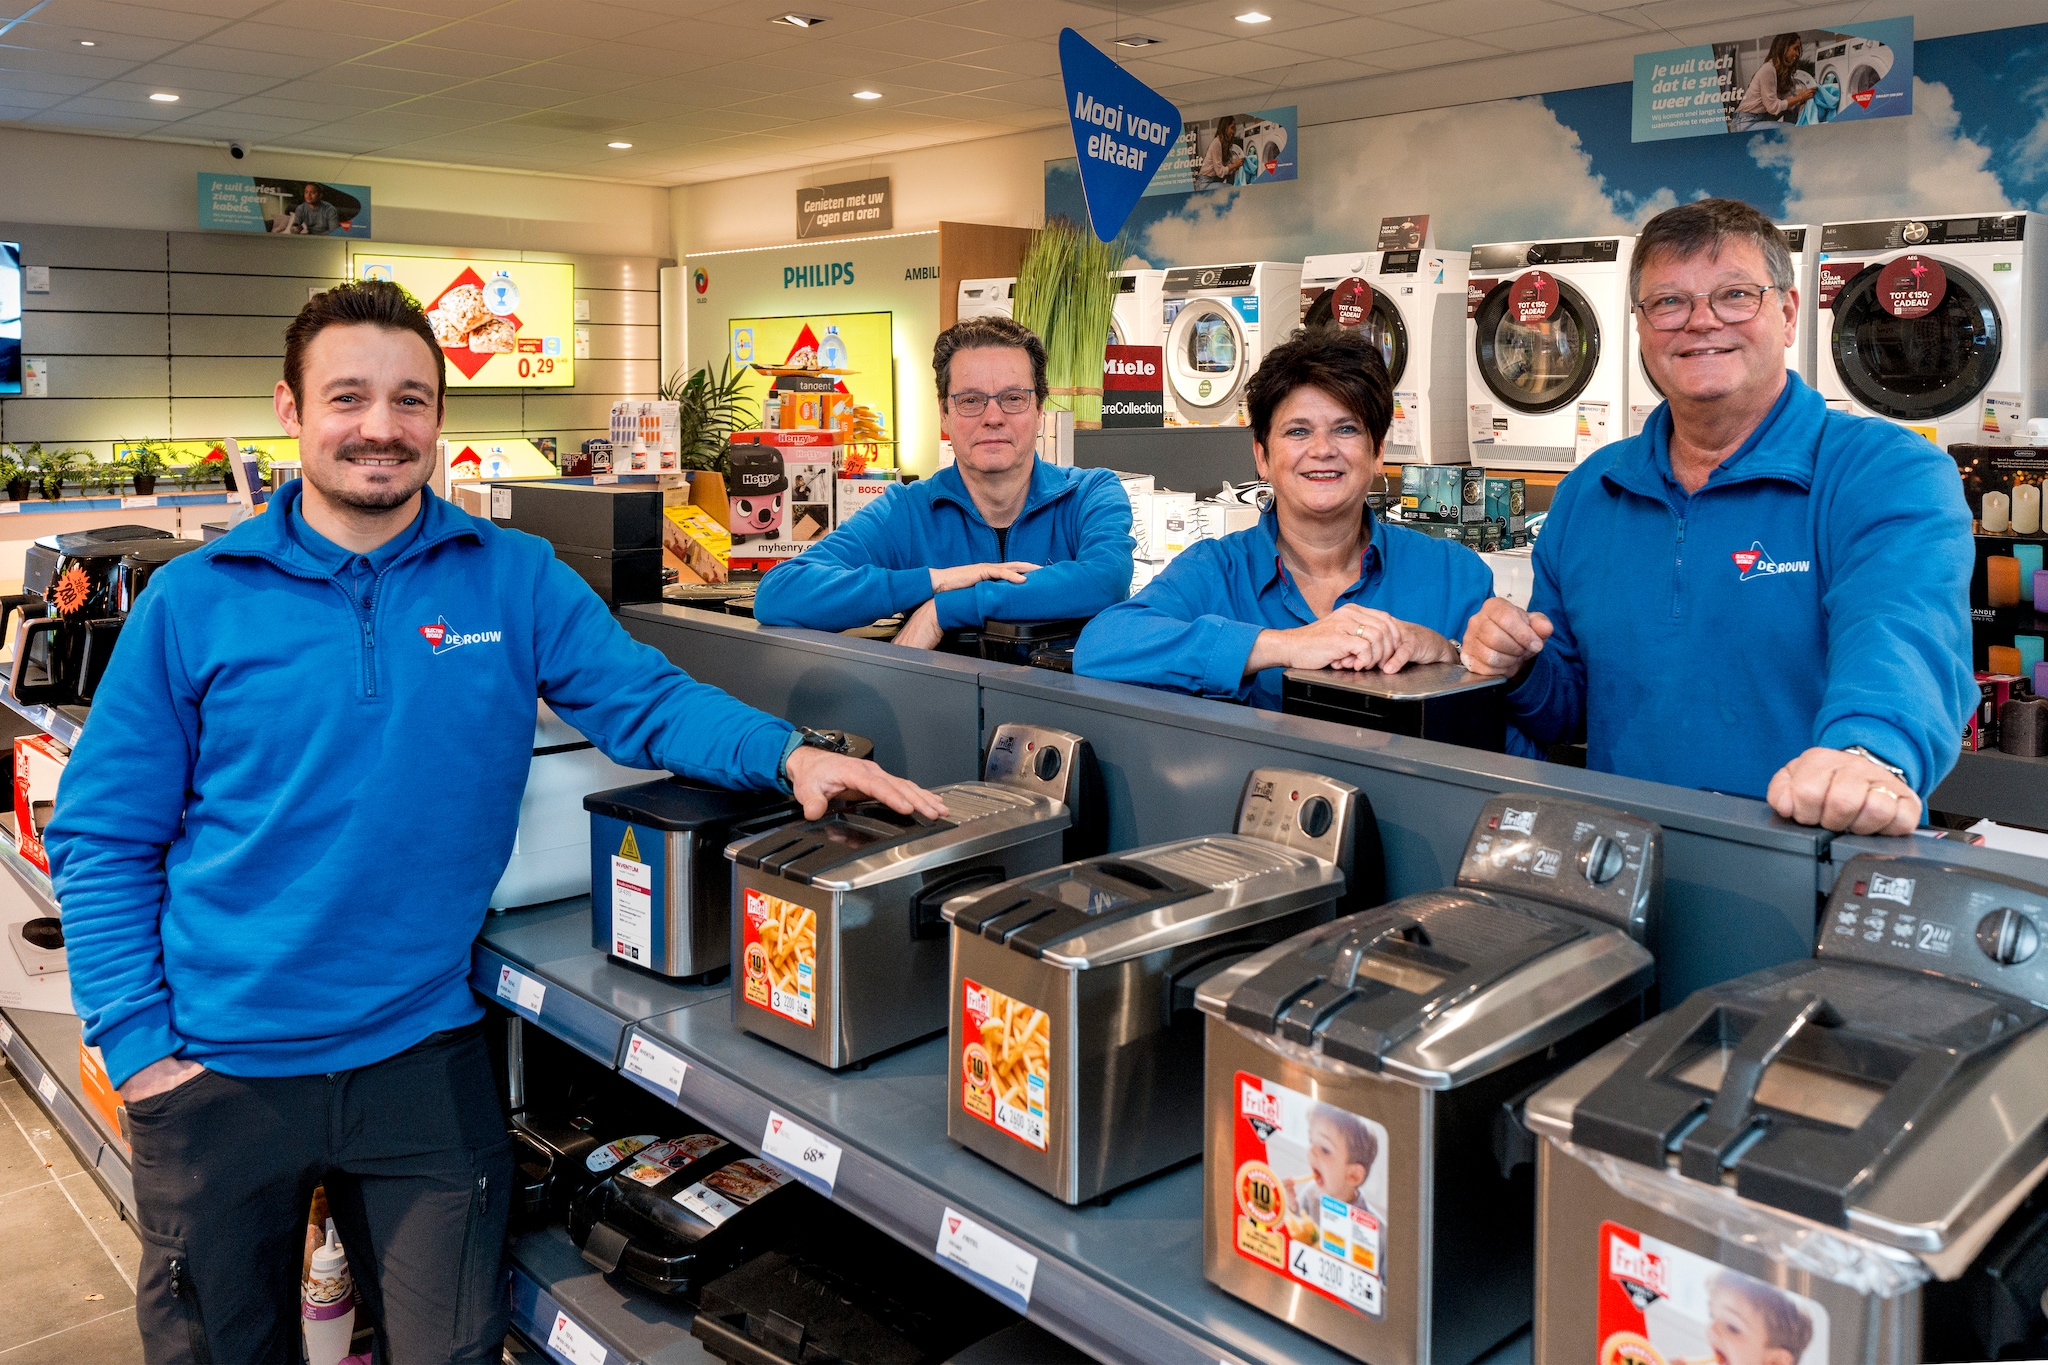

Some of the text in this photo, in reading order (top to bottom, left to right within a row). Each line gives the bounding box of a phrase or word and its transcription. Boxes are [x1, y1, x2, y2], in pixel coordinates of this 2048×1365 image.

[1651, 54, 1734, 81] Je wil toch
[1652, 70, 1733, 94] dat ie snel
[1651, 86, 1747, 111] weer draait.
[1074, 91, 1171, 147] Mooi voor
[1662, 112, 1684, 120] komen
[1685, 110, 1699, 118] snel
[1698, 109, 1716, 117] langs
[1651, 119, 1690, 129] wasmachine
[1087, 132, 1148, 172] elkaar
[1176, 143, 1197, 157] snel
[1158, 161, 1173, 172] eer
[211, 181, 276, 195] Je wil series
[212, 192, 267, 206] zien, geen
[212, 201, 251, 213] kabels.
[803, 191, 885, 214] Genieten met uw
[816, 207, 880, 228] ogen en oren
[783, 261, 855, 289] PHILIPS
[904, 265, 940, 281] AMBILI
[1889, 292, 1907, 300] TOT
[1893, 299, 1929, 307] CADEAU
[1339, 310, 1361, 319] CADEAU
[518, 357, 554, 378] 0.29
[1103, 359, 1156, 376] Miele
[1101, 401, 1162, 415] areCollection
[778, 434, 808, 444] Henry
[742, 473, 772, 486] Hetty
[1757, 560, 1810, 573] DE ROUW
[445, 631, 502, 645] DE ROUW
[1254, 781, 1273, 797] Fritel
[1503, 812, 1532, 833] Fritel
[615, 861, 639, 873] INVENTUM
[1532, 849, 1546, 873] 2
[1872, 877, 1911, 902] Fritel
[749, 899, 766, 913] Fritel
[1918, 923, 1935, 950] 2
[752, 954, 762, 970] 10
[773, 991, 780, 1008] 3
[967, 990, 989, 1012] Fritel
[971, 1057, 983, 1075] 10
[1244, 1089, 1282, 1122] Fritel
[997, 1105, 1006, 1124] 4
[757, 1163, 782, 1179] Tefal
[1251, 1180, 1271, 1206] 10
[1293, 1247, 1309, 1276] 4
[1318, 1257, 1343, 1287] 3200
[1615, 1246, 1667, 1284] Fritel
